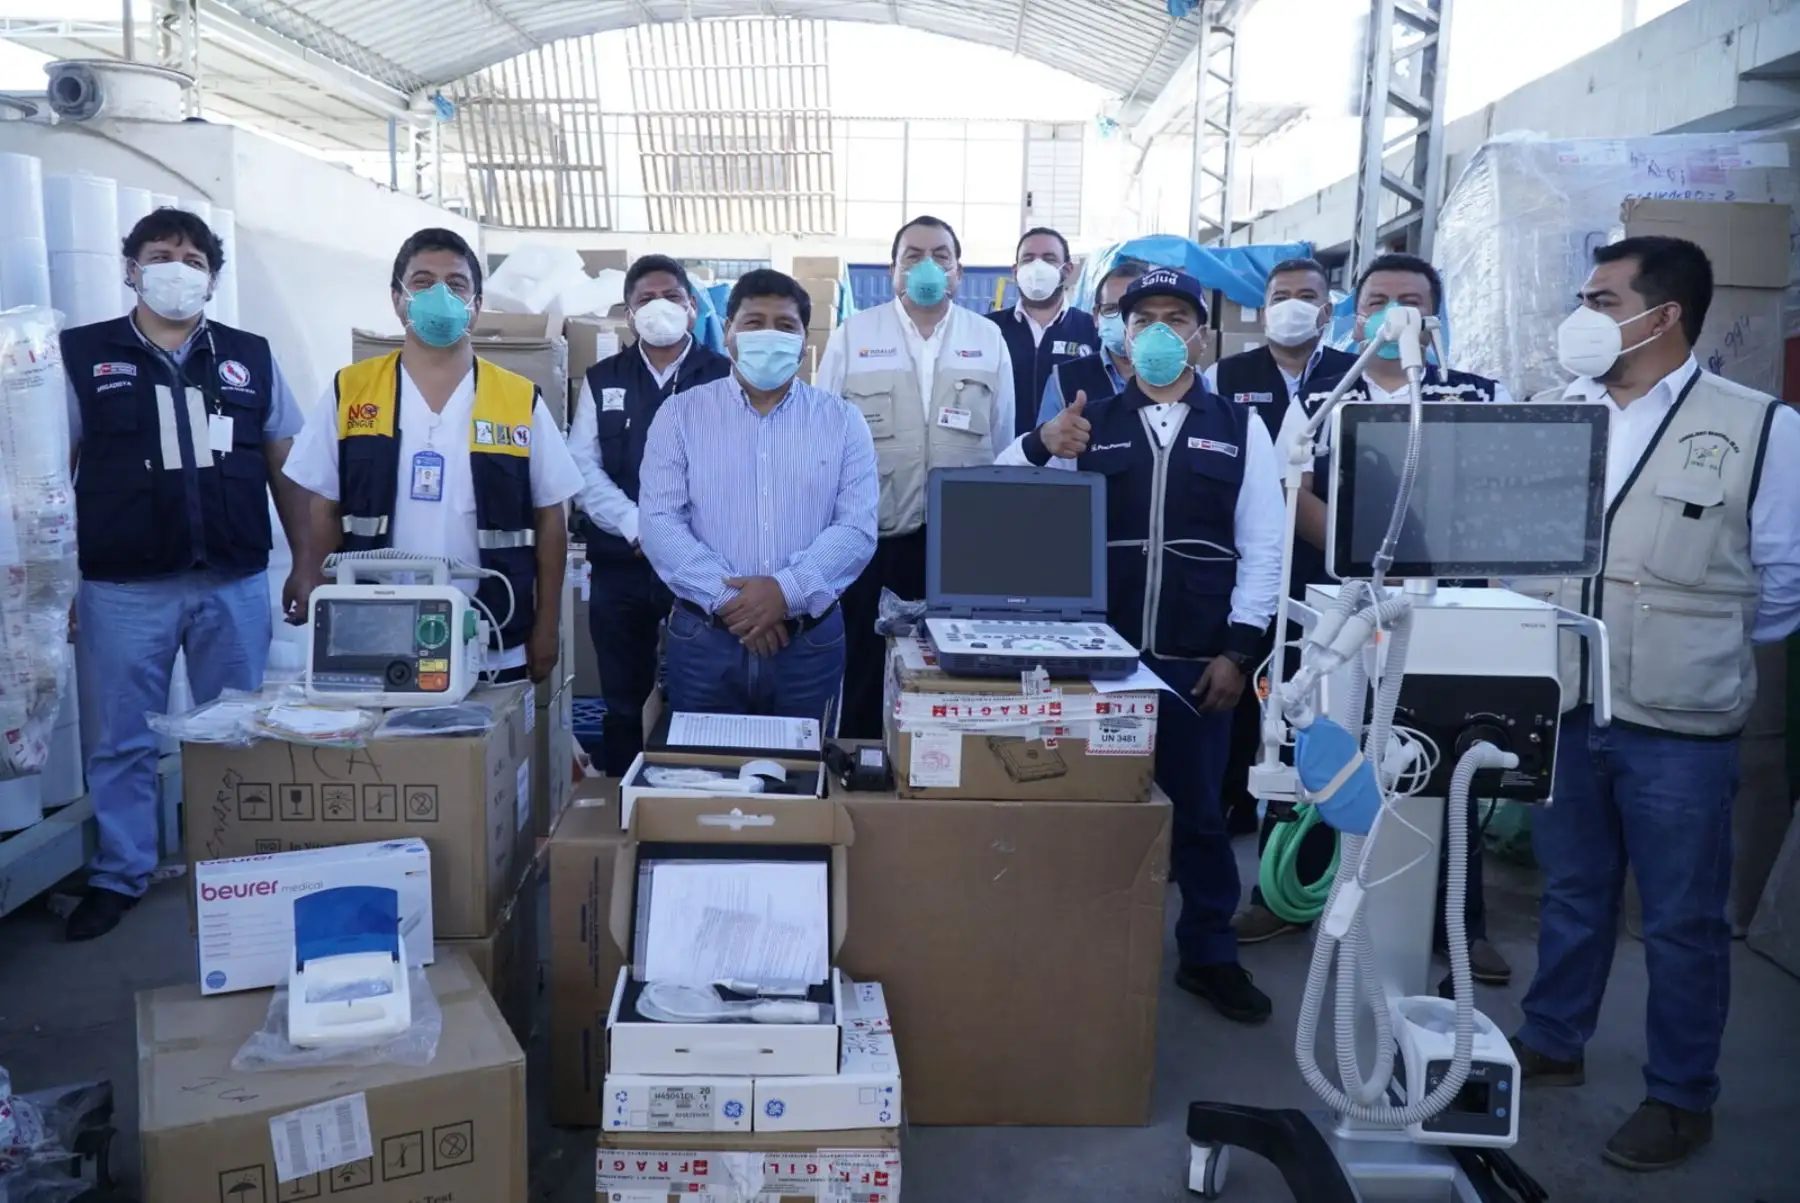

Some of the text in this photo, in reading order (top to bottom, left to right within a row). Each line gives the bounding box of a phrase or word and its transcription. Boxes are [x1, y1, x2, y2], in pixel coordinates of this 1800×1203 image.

[1140, 274, 1177, 288] Salud
[348, 403, 378, 420] NO
[346, 418, 375, 429] DENGUE
[1101, 734, 1137, 744] UN 3481
[201, 880, 324, 901] beurer medical
